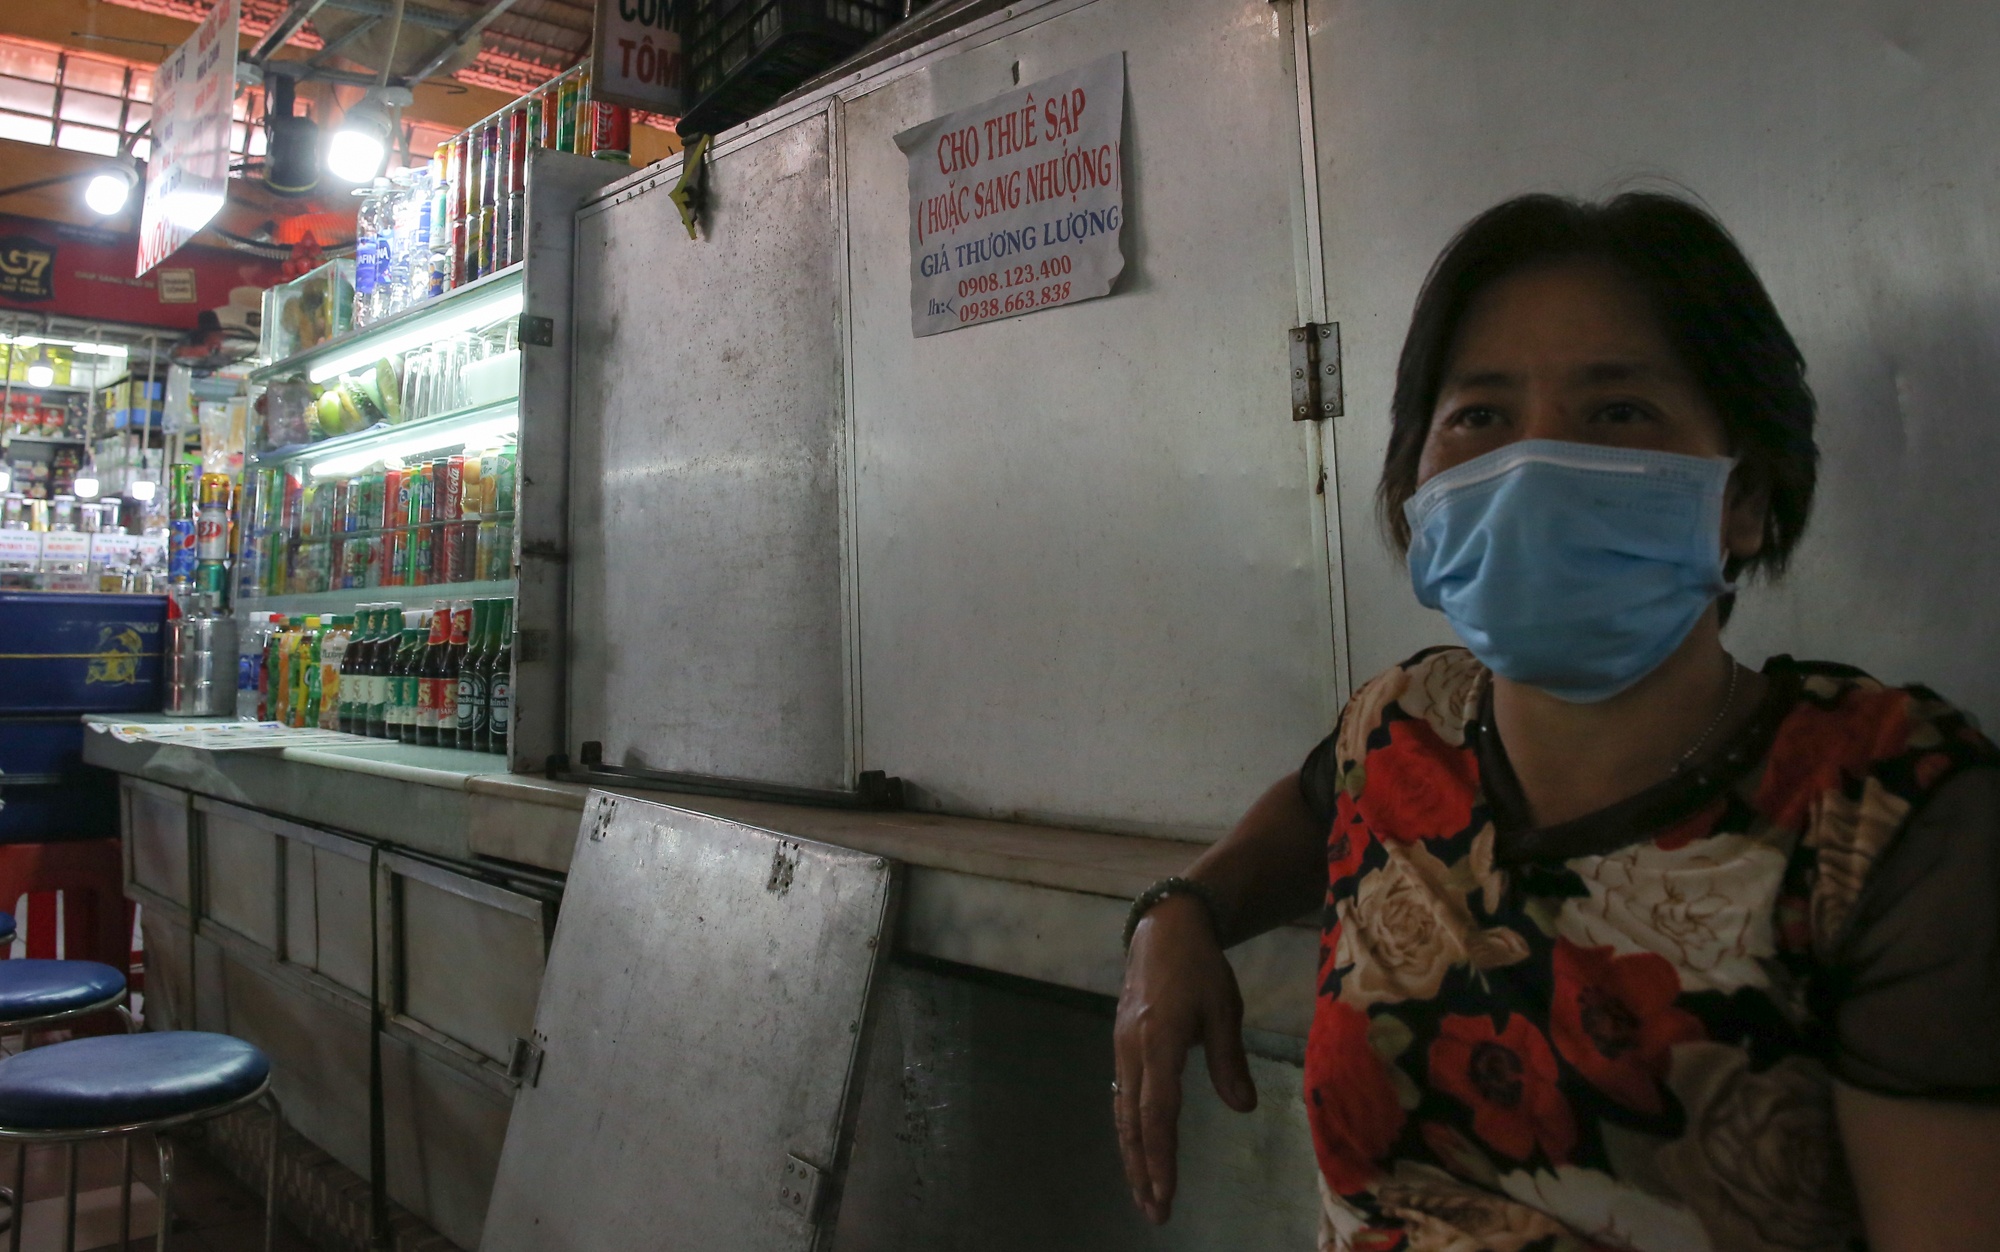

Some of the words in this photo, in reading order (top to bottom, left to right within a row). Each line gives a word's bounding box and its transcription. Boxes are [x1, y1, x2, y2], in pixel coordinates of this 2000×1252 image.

[937, 126, 980, 175] CHO
[984, 92, 1037, 161] THUÊ
[1044, 87, 1087, 145] SẠP
[974, 169, 1021, 220] SANG
[0, 248, 51, 278] G7
[920, 242, 951, 278] GIÁ
[955, 225, 1036, 268] THƯƠNG
[1043, 205, 1120, 247] LƯỢNG
[958, 254, 1073, 299] 0908.123.400
[959, 280, 1072, 323] 0938.663.838
